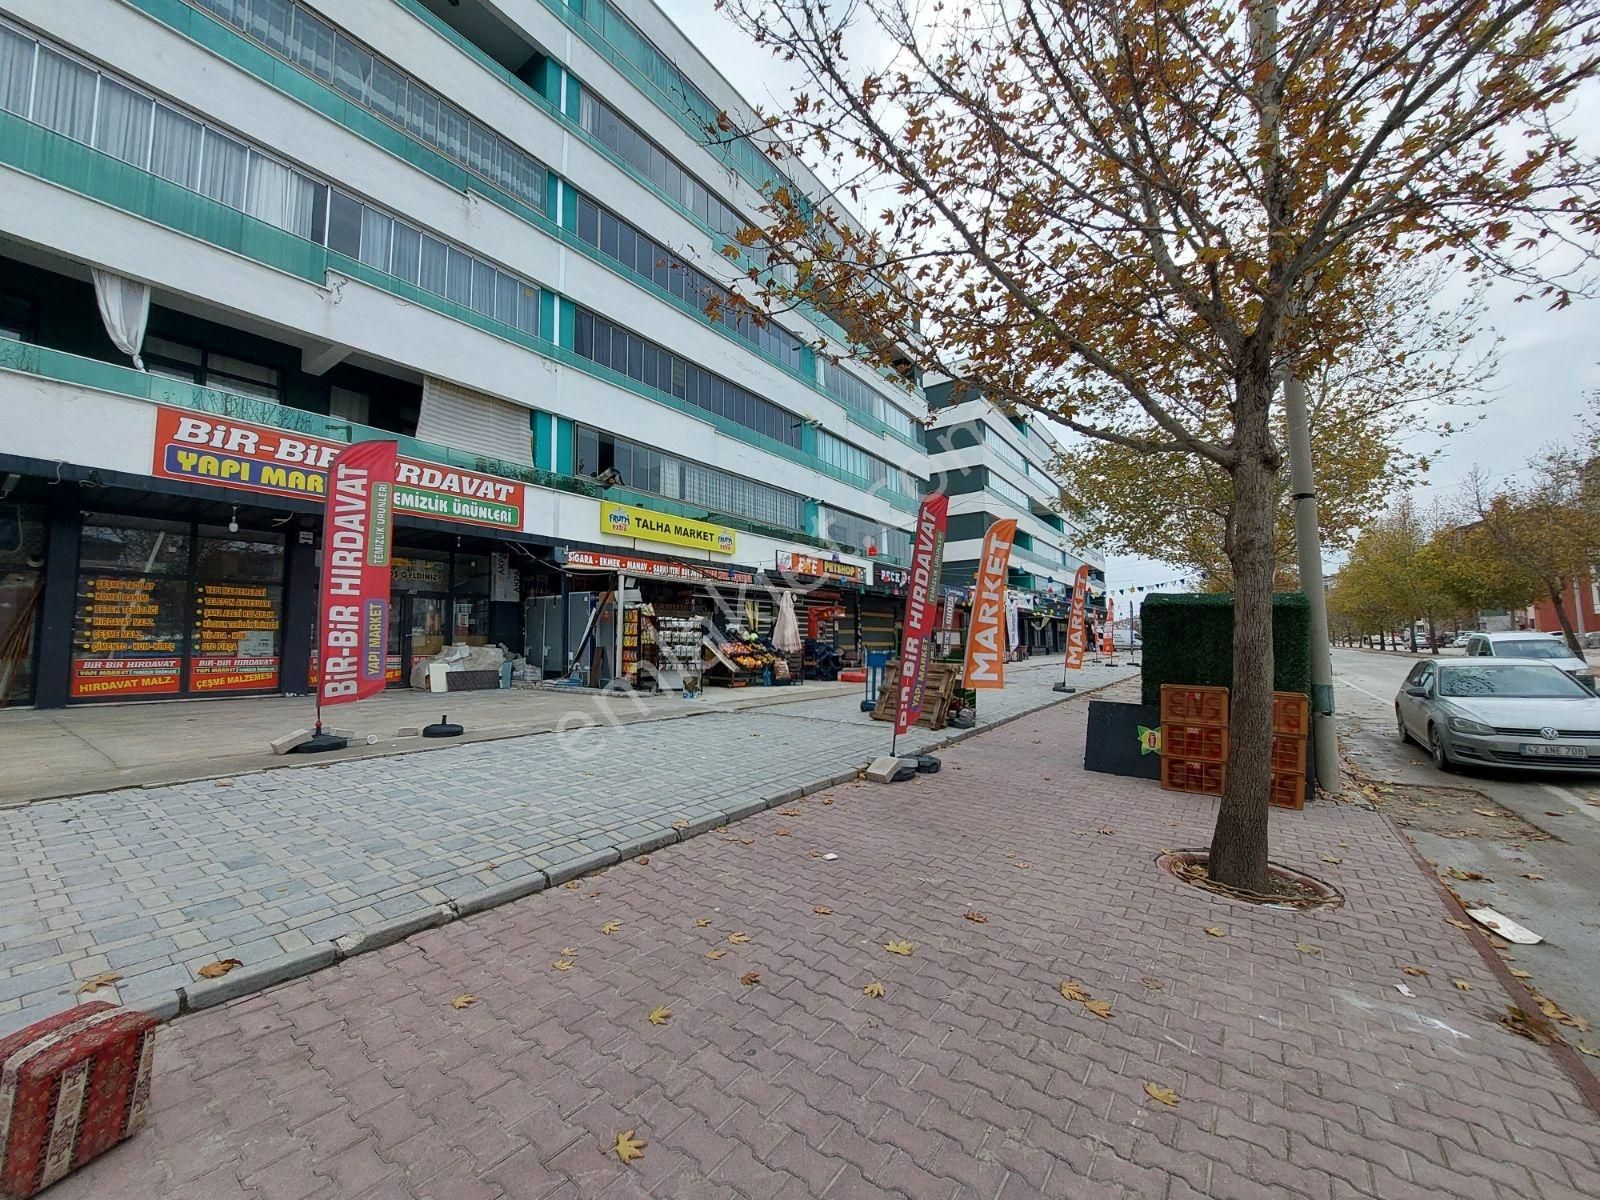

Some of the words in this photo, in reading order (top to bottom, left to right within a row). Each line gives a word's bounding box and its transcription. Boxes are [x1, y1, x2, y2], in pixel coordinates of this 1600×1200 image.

[177, 450, 250, 481] YAPI
[452, 499, 511, 523] ÜRÜNLERİ
[330, 463, 368, 596] HIRDAVAT
[634, 517, 671, 534] TALHA
[674, 525, 715, 542] MARKET
[600, 556, 620, 568] EKMEK
[910, 506, 936, 630] HIRDAVAT
[970, 532, 1010, 681] MARKET
[93, 617, 132, 626] HIRDAVAT
[368, 603, 382, 648] MARKET
[1067, 573, 1086, 665] MARKET
[126, 660, 176, 668] HIRDAVAT
[233, 658, 275, 666] HIRDAVAT
[368, 651, 380, 675] YAPI
[912, 683, 923, 707] YAPI
[918, 637, 929, 681] MARKET
[80, 679, 138, 693] HIRDAVAT
[141, 676, 175, 686] MALZ.
[196, 677, 225, 689] ÇEŞME
[1527, 745, 1540, 754] 42
[1544, 746, 1561, 755] ANE
